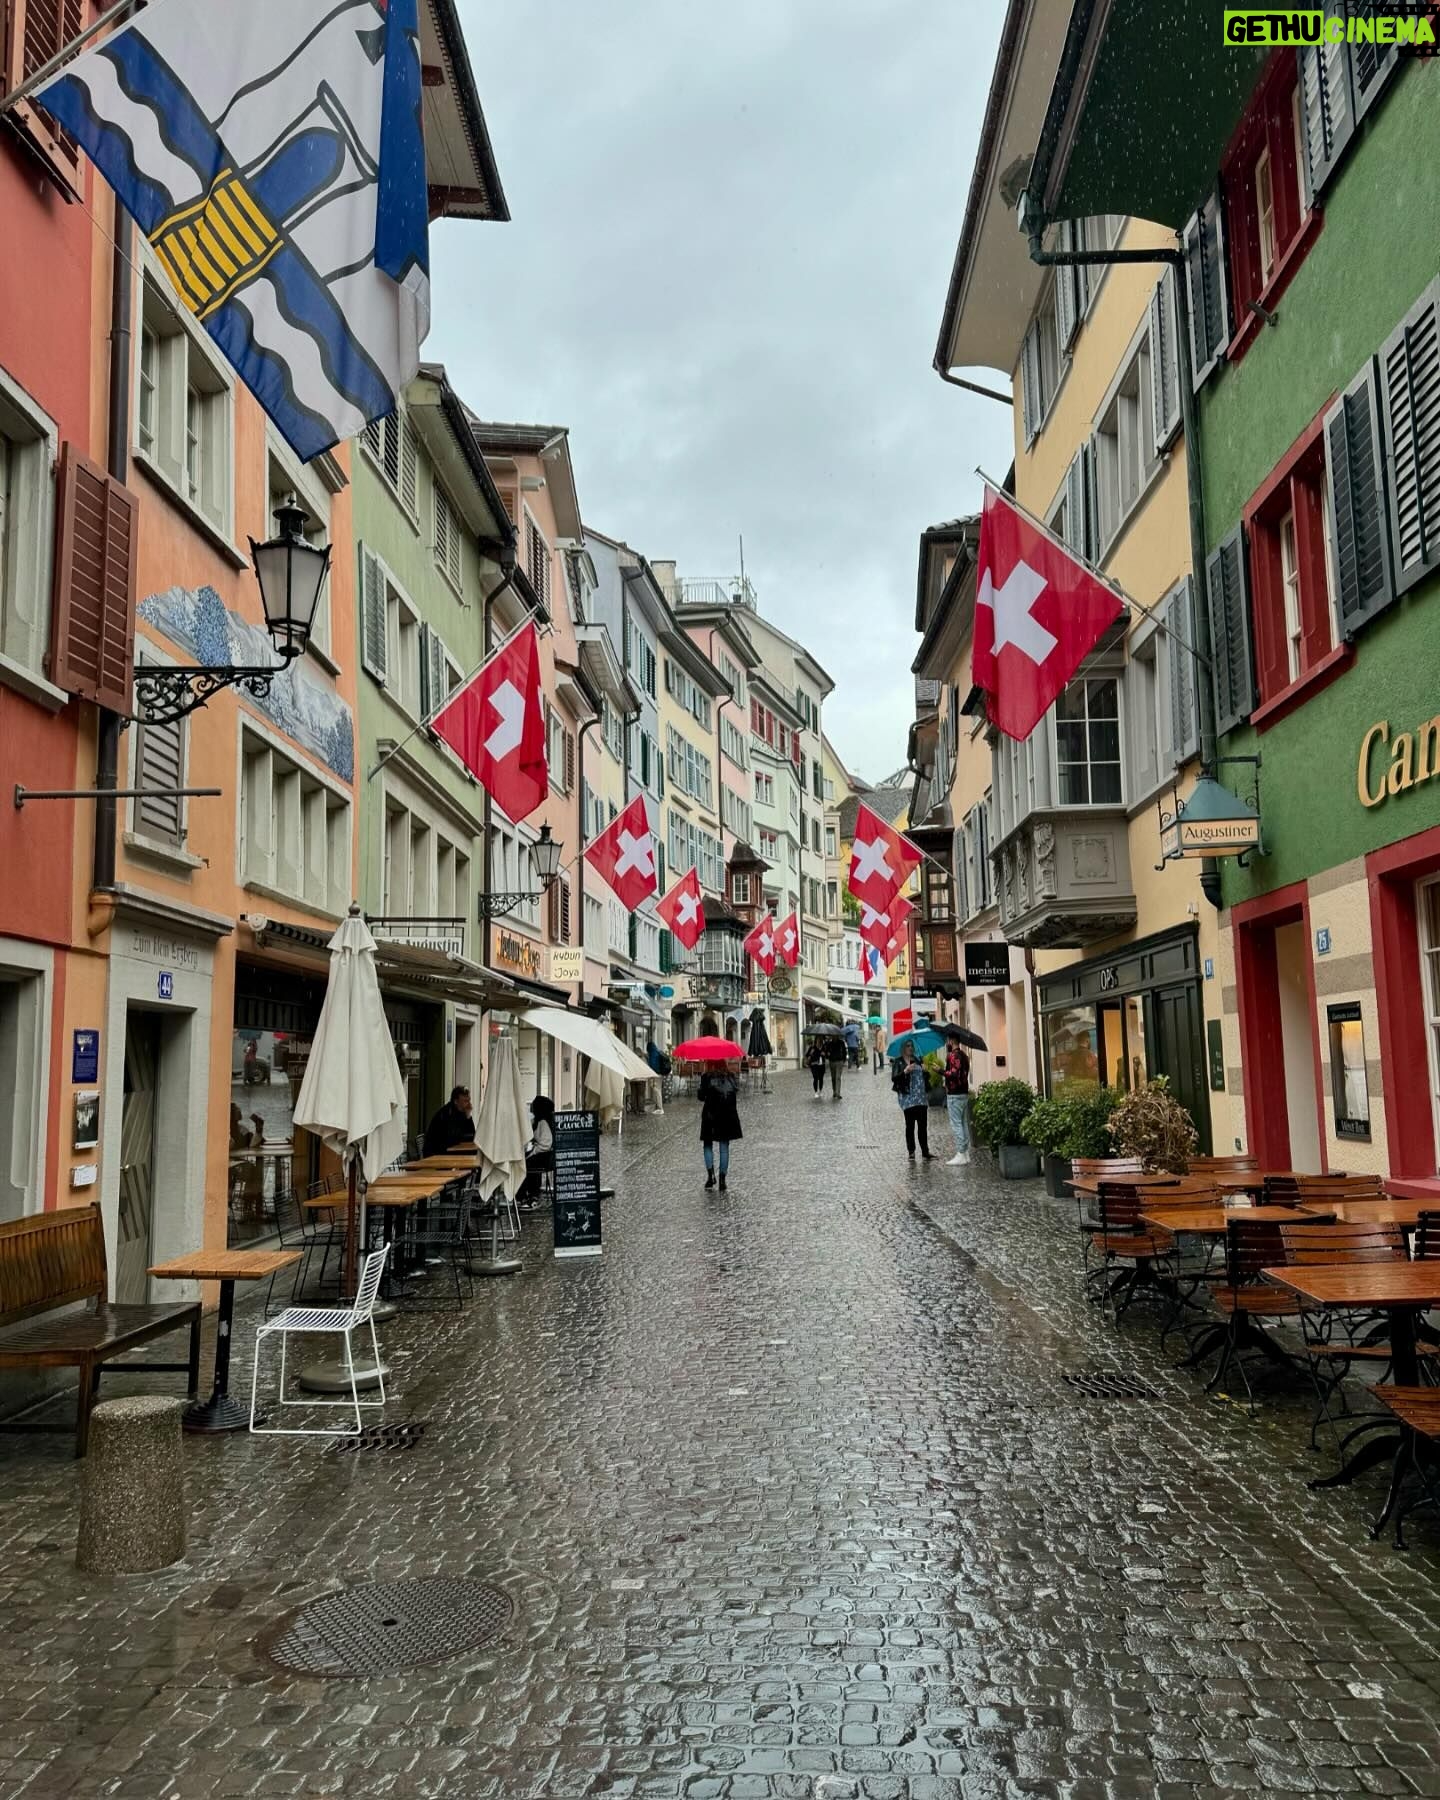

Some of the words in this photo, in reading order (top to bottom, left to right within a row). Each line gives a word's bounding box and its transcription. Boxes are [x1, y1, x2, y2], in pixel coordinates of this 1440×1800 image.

[1185, 826, 1253, 842] Augustiner
[968, 966, 1008, 975] meister
[161, 976, 171, 994] 44
